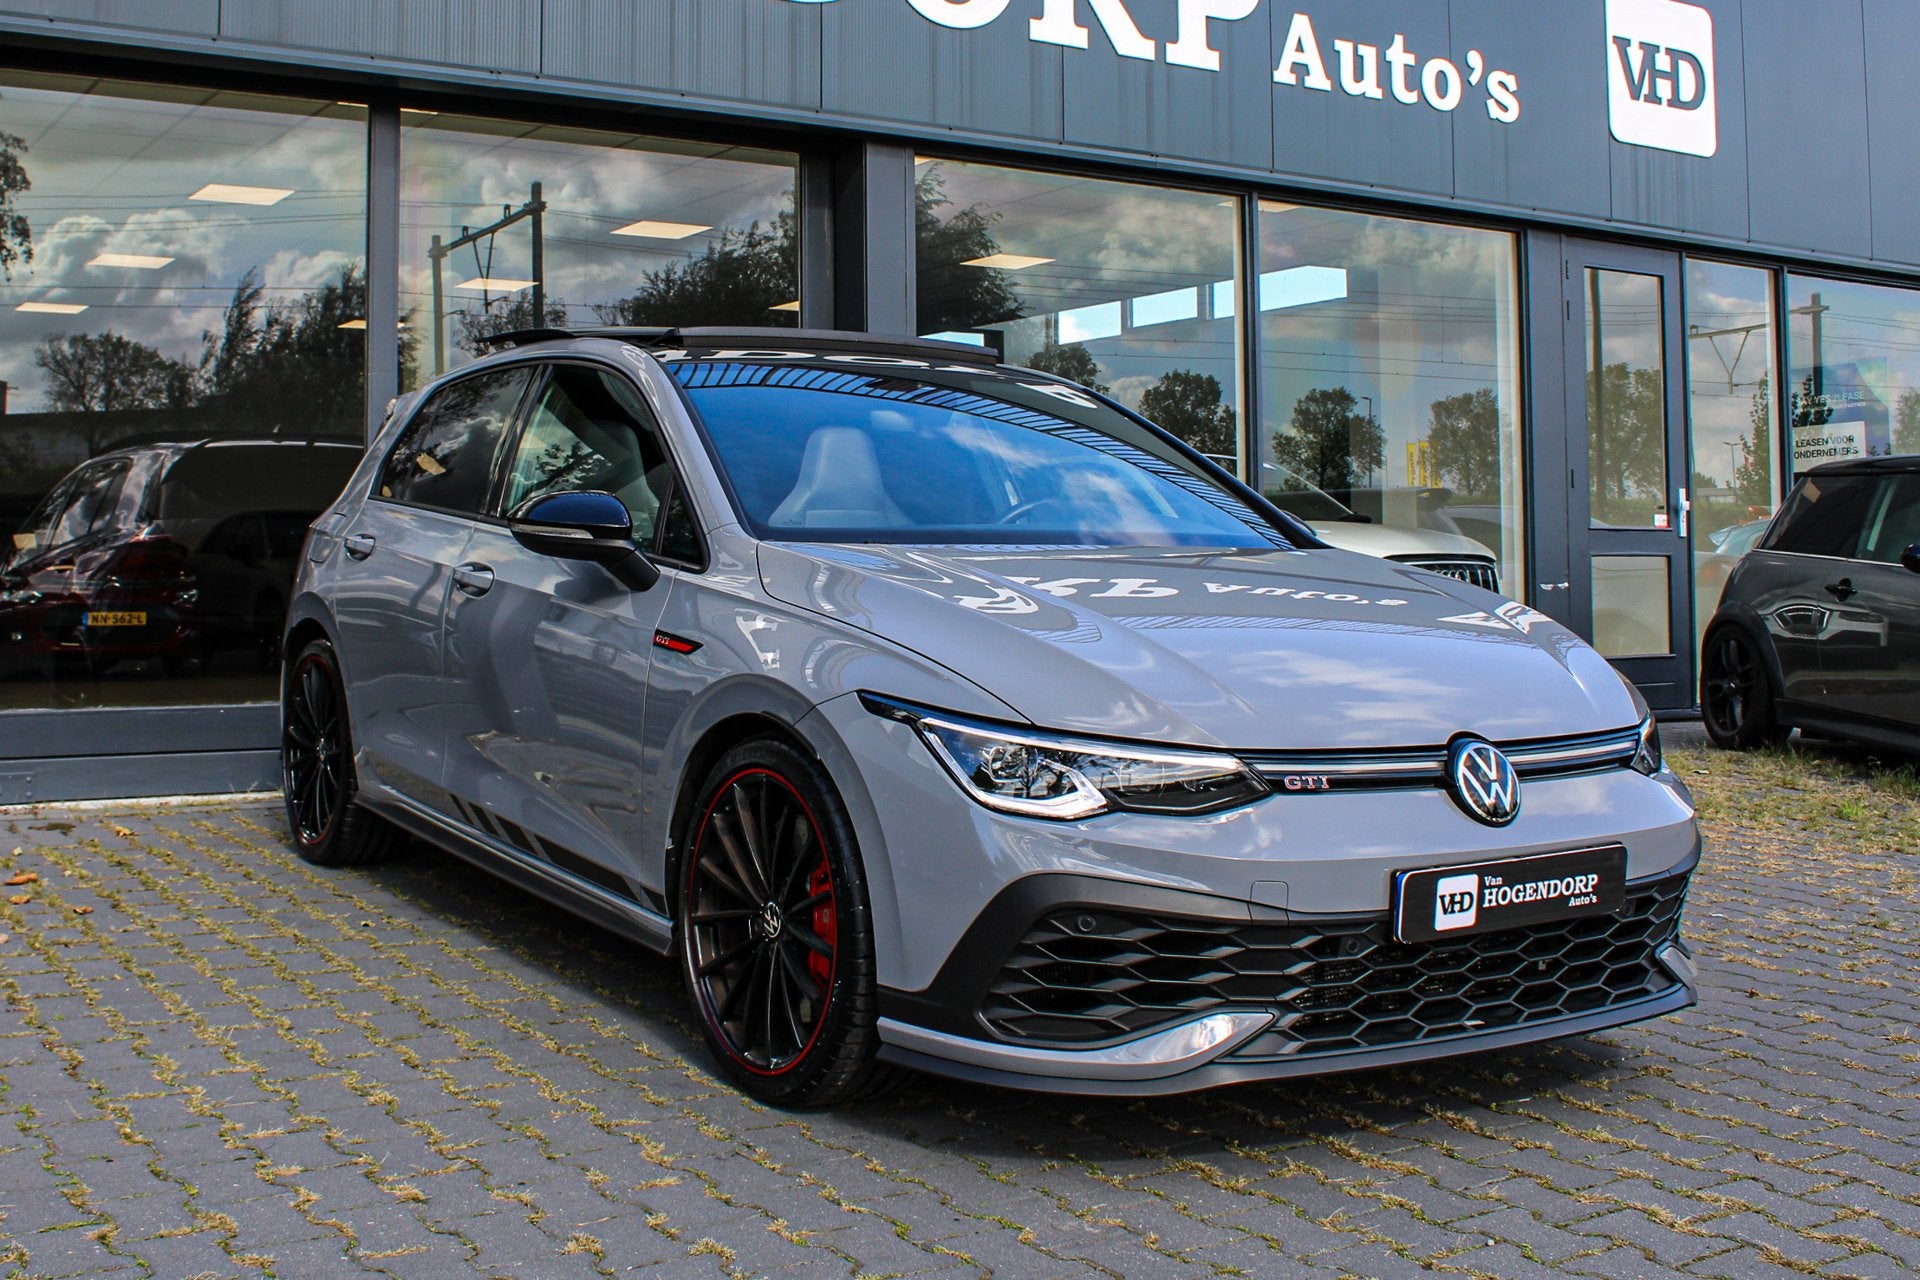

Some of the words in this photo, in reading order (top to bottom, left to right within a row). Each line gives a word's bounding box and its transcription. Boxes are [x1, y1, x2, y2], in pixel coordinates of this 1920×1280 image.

[1273, 13, 1520, 124] Auto's
[1612, 35, 1706, 111] VHD
[1814, 394, 1831, 403] YES
[1796, 437, 1828, 448] LEASEN
[1830, 435, 1854, 444] VOOR
[1794, 446, 1858, 459] ONDERNEMERS
[91, 613, 144, 624] NN-562-L
[1284, 775, 1330, 790] GTI
[1484, 876, 1502, 887] Van
[1483, 874, 1598, 908] HOGENDORP
[1439, 890, 1474, 916] VHD
[1568, 894, 1598, 907] Auto's
